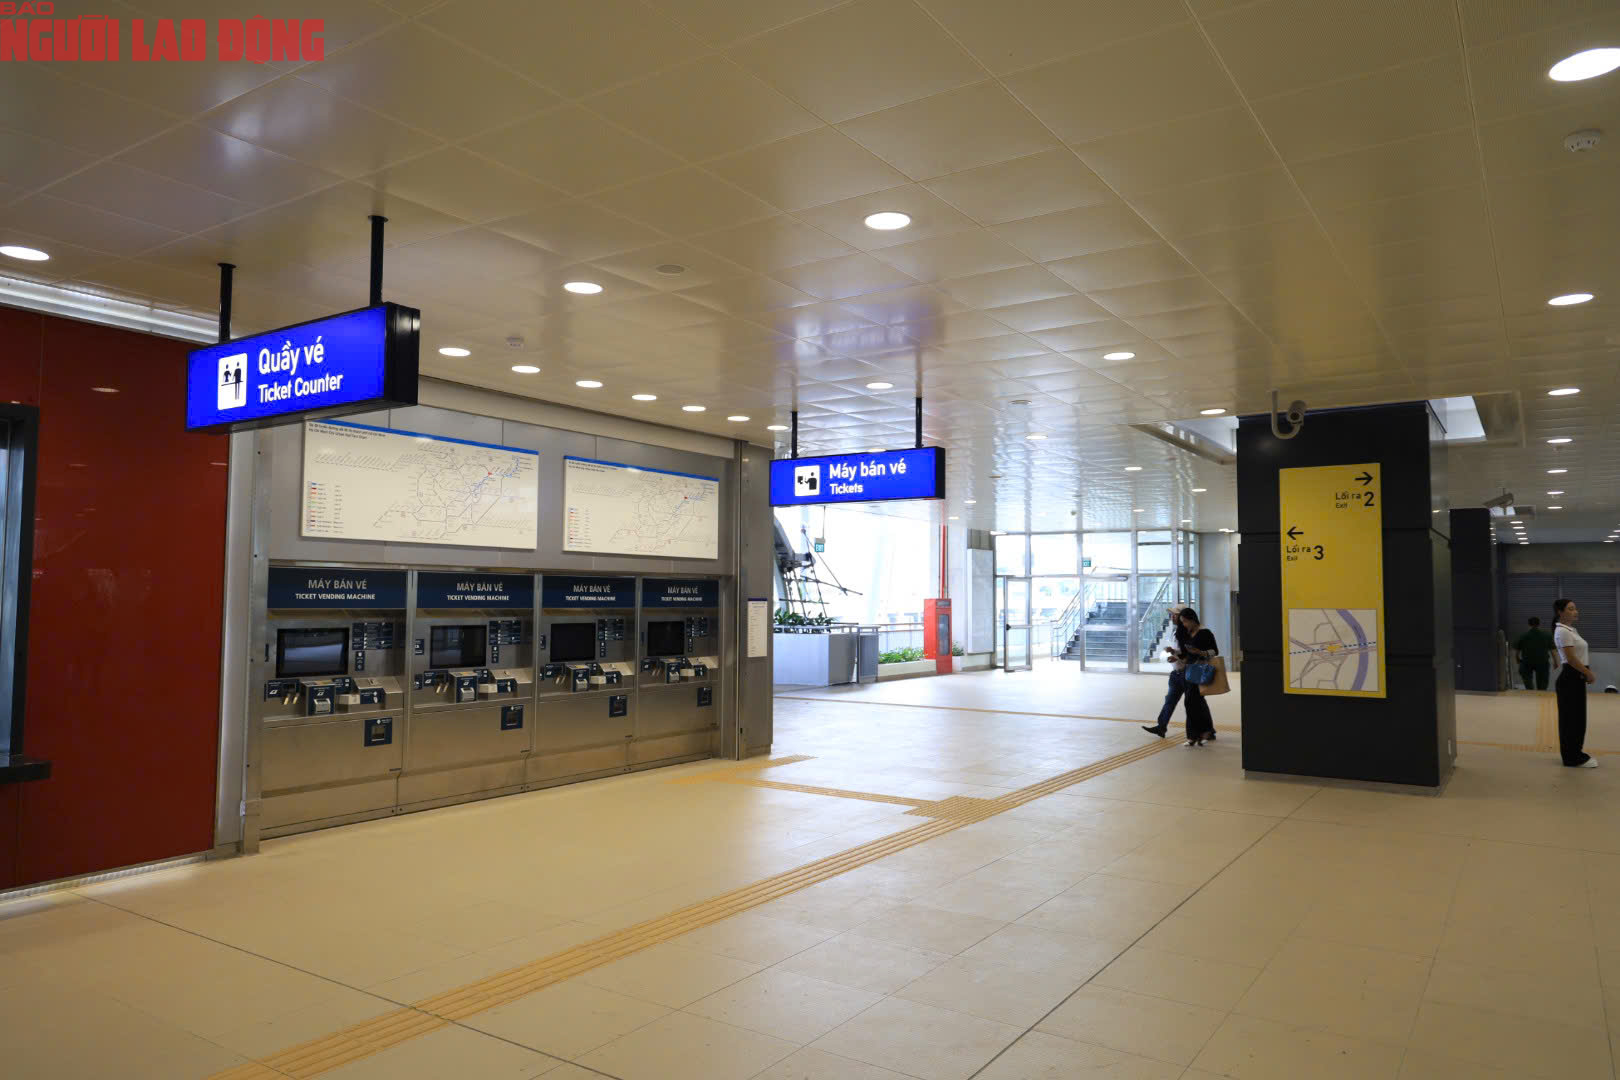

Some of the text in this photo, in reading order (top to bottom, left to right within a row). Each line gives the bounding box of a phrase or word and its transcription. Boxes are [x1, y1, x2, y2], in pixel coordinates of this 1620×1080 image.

[258, 335, 324, 376] Quầy vé
[258, 373, 343, 403] Ticket Counter
[829, 458, 906, 481] Máy bán vé
[829, 483, 863, 495] Tickets
[1335, 491, 1375, 507] Lối ra 2
[1286, 544, 1300, 553] Lối
[1313, 545, 1324, 560] 3
[308, 578, 368, 590] MÁY BÁN VÉ
[456, 581, 503, 592] MÁY BÁN VÉ
[573, 584, 588, 593] MÁY
[590, 584, 602, 593] BÁN
